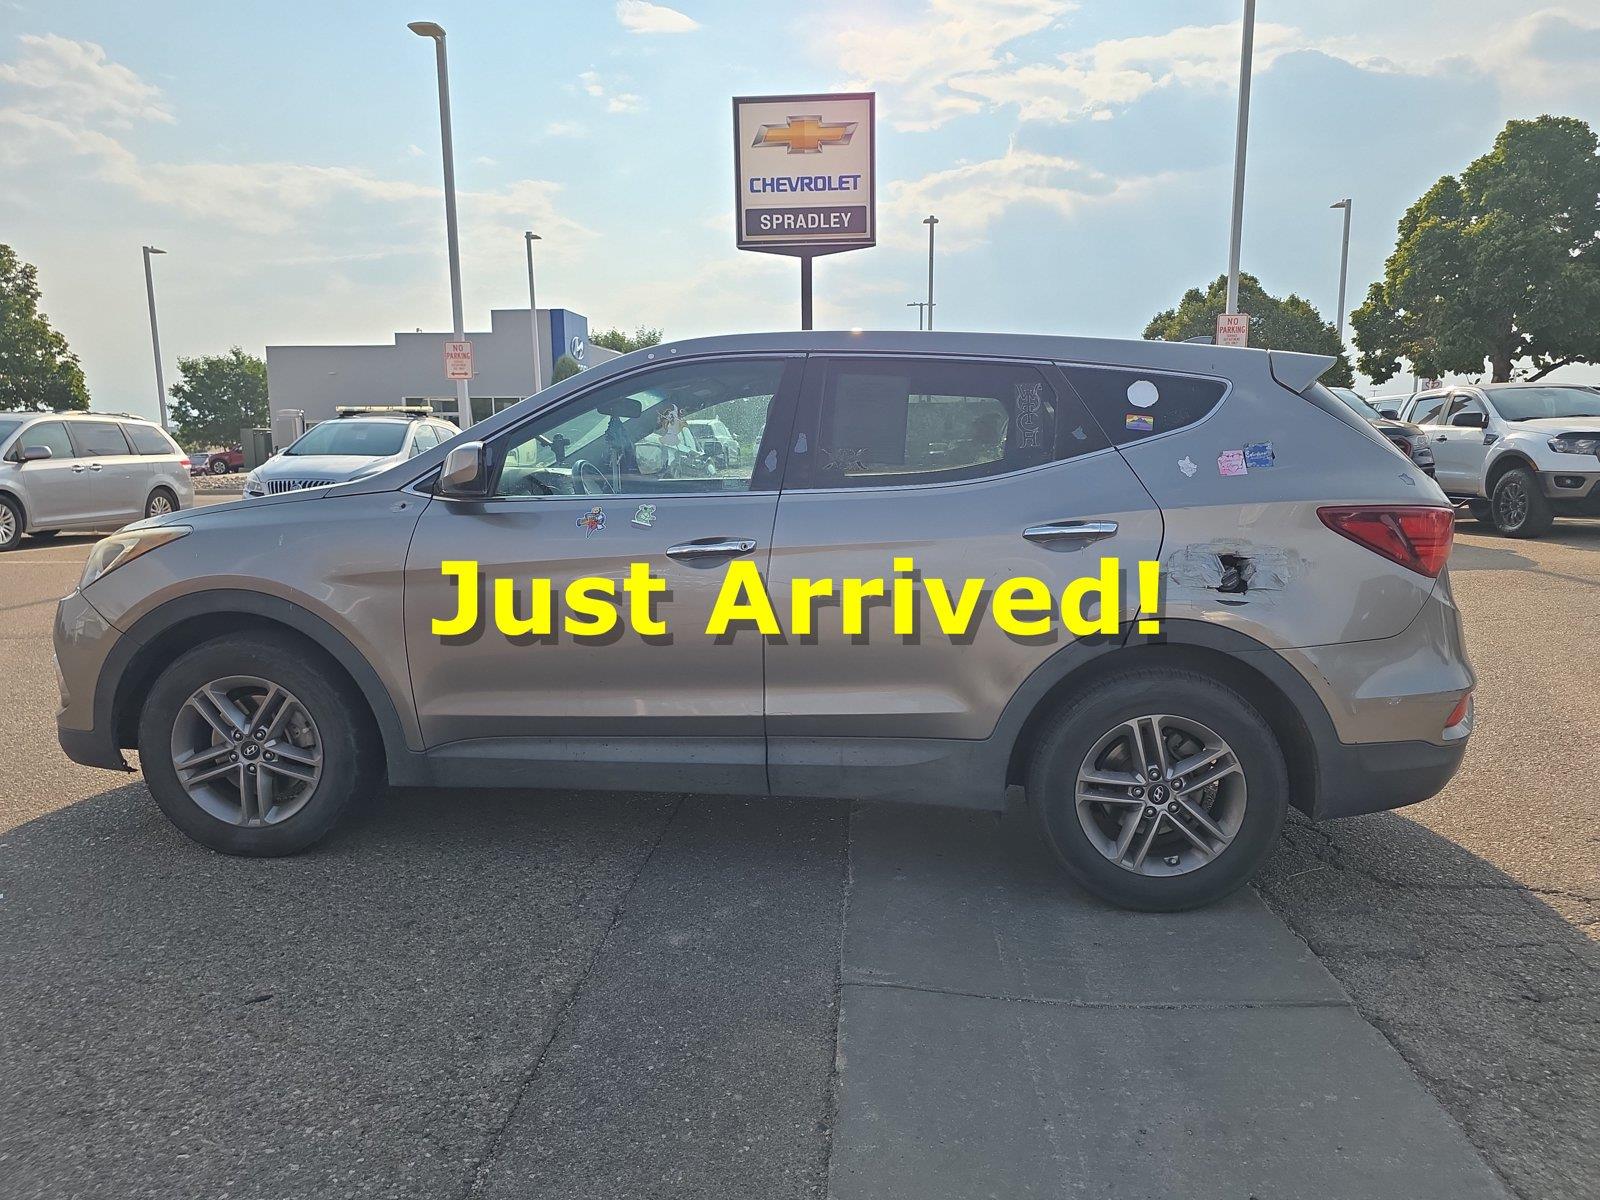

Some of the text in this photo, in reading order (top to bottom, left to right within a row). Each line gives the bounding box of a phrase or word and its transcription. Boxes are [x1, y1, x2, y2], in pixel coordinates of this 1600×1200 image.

[749, 175, 861, 193] CHEVROLET
[760, 213, 852, 230] SPRADLEY
[1227, 317, 1239, 325] NO
[1219, 326, 1246, 334] PARKING
